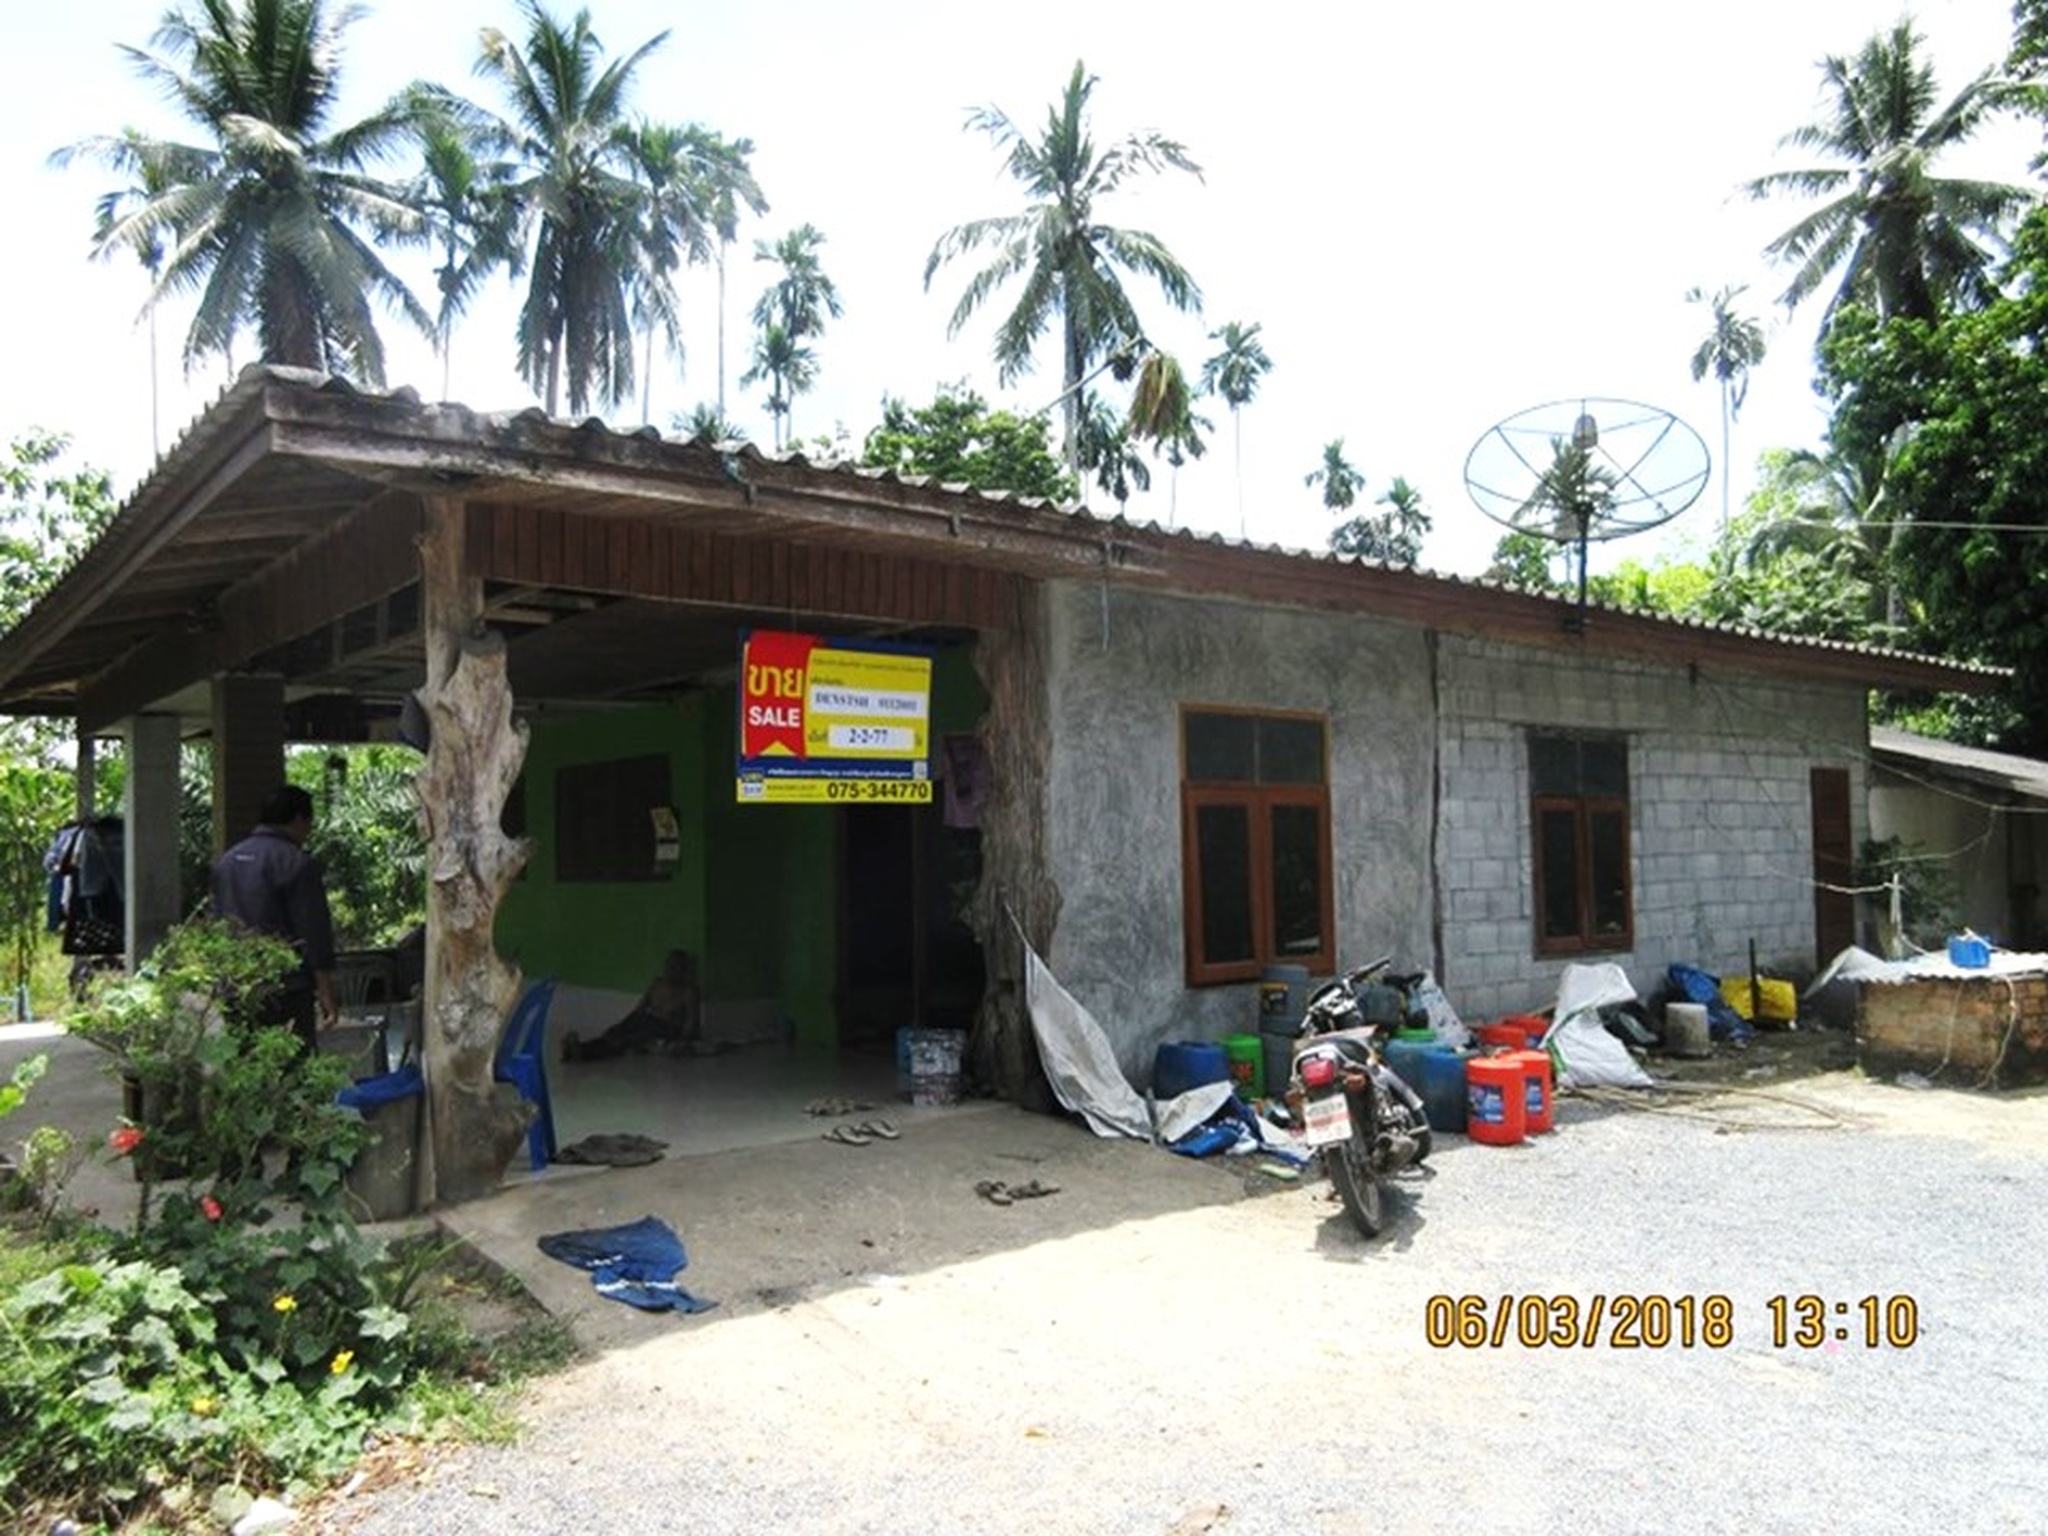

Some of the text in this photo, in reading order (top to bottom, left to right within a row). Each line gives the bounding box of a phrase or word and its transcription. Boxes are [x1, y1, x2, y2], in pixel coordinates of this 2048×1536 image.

[748, 665, 803, 698] ขาย
[748, 706, 801, 727] SALE
[849, 728, 889, 744] 2-2-77
[827, 782, 928, 799] 075-344770
